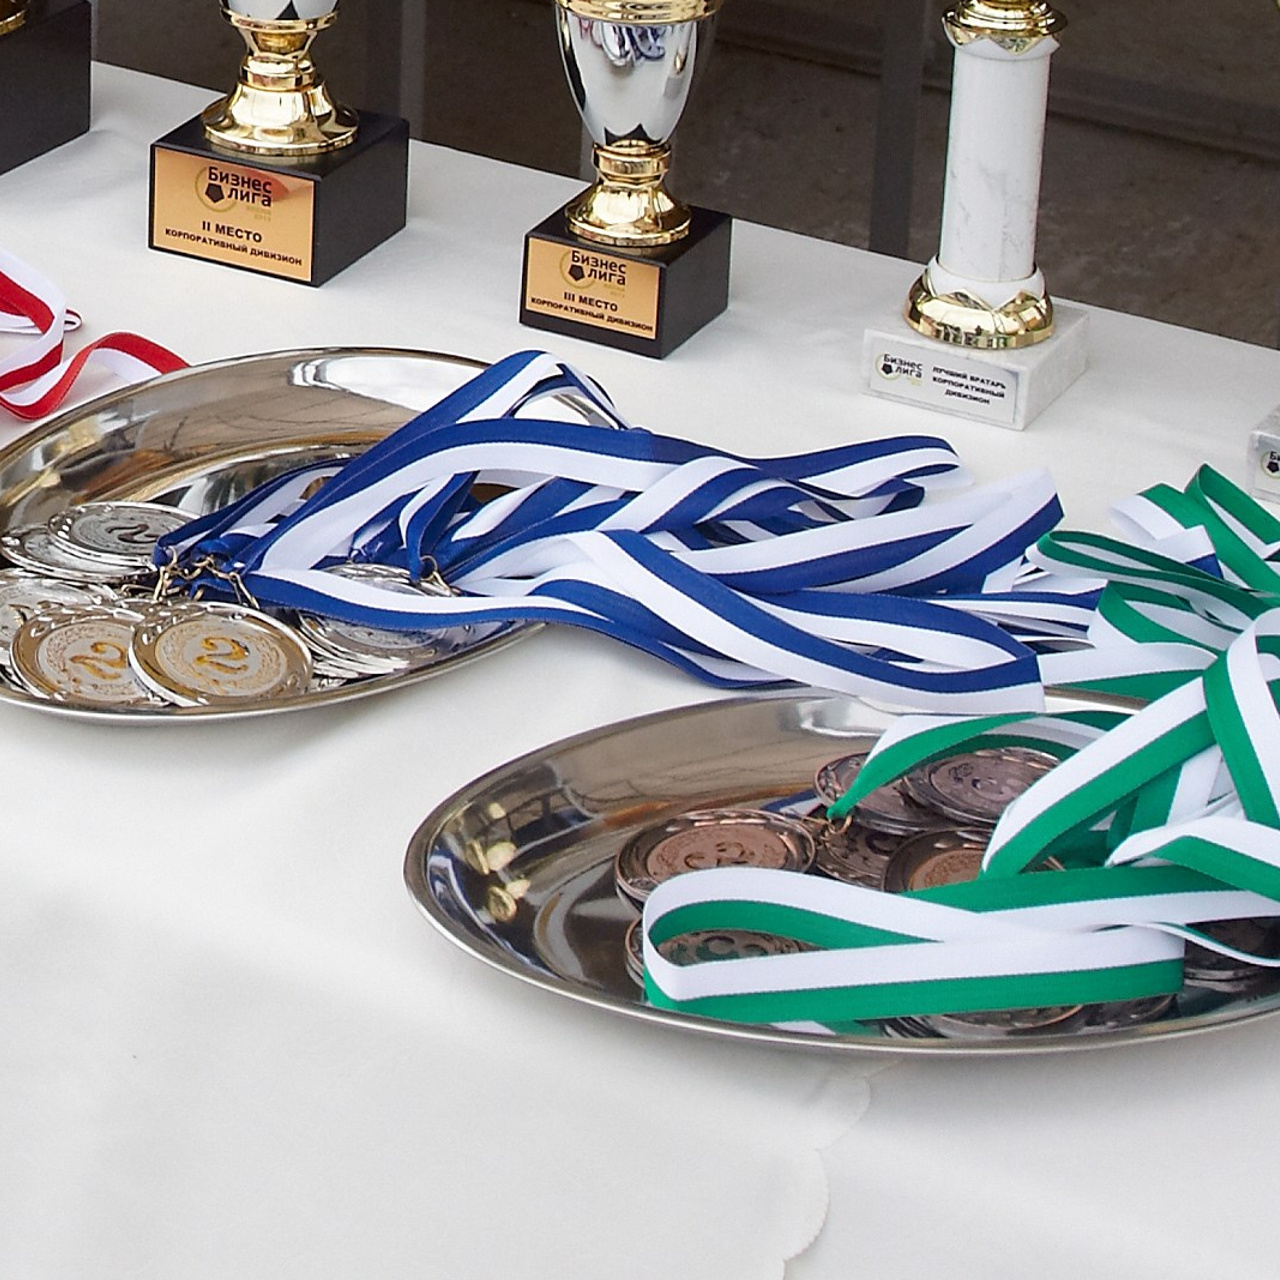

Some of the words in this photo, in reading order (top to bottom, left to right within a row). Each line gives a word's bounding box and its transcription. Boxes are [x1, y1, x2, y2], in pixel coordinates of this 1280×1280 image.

[208, 166, 272, 194] Бизнес
[227, 188, 272, 207] лига
[215, 223, 262, 243] МЕСТО
[165, 228, 248, 253] КОРПОРАТИВНЫЙ
[250, 248, 302, 266] ДИВИЗИОН
[571, 250, 627, 274] Бизнес
[587, 269, 626, 286] лига
[531, 297, 605, 321] КОРПОРАТИВНЫЙ
[606, 315, 654, 332] ДИВИЗИОН
[578, 294, 618, 312] МЕСТО
[883, 353, 923, 370] Бизнес
[895, 367, 923, 378] лига
[932, 366, 968, 380] ЛУЧШИЙ
[969, 375, 1007, 390] ВРАТАРЬ
[932, 376, 1005, 399] КОРПОРАТИВНЫЙ
[945, 389, 990, 405] ДИВИЗИОН
[70, 641, 128, 680] 2
[194, 636, 250, 675] 2
